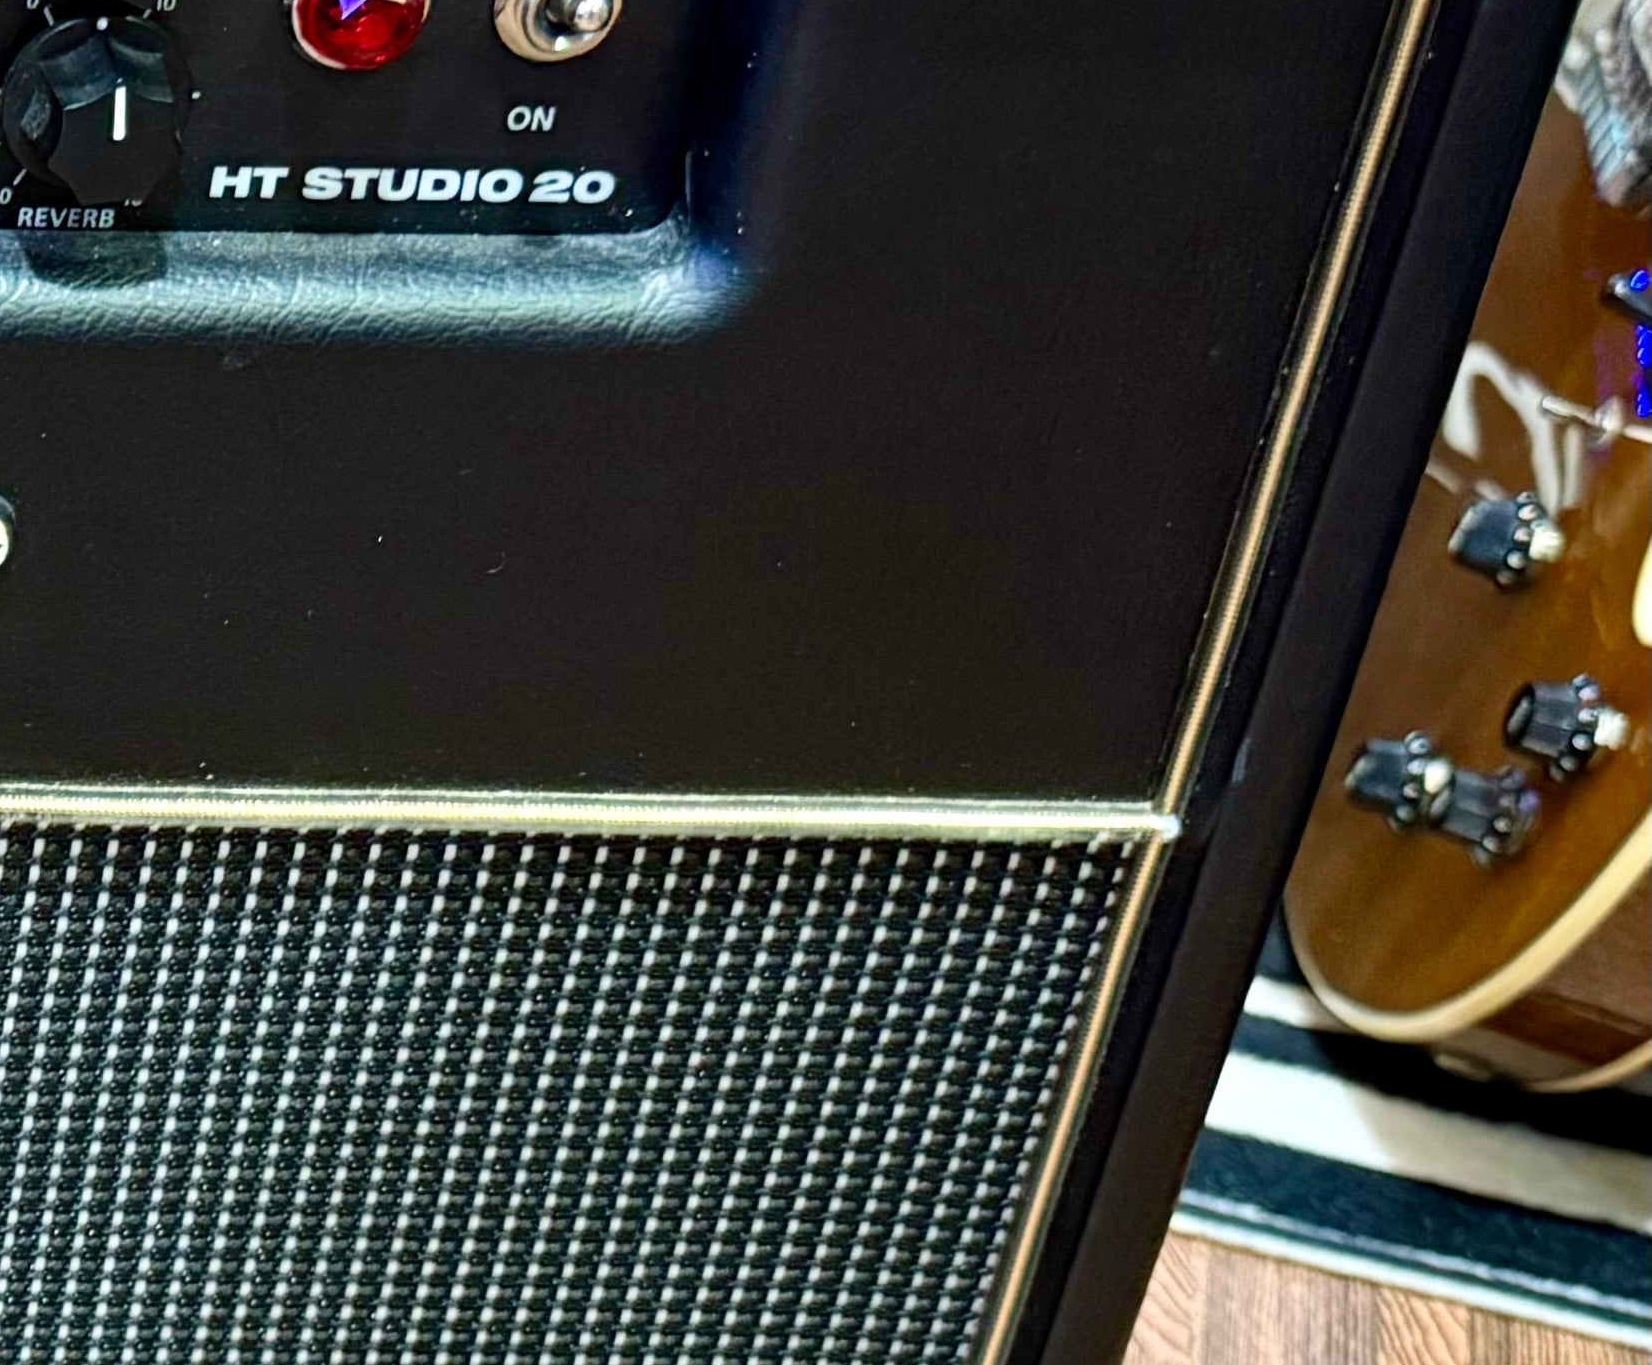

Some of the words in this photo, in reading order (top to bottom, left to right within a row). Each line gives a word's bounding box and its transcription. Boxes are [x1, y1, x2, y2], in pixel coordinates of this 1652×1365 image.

[507, 106, 556, 132] ON
[209, 165, 290, 199] HT
[302, 166, 524, 203] STUDIO
[528, 170, 616, 204] 20
[17, 206, 115, 228] REVERB
